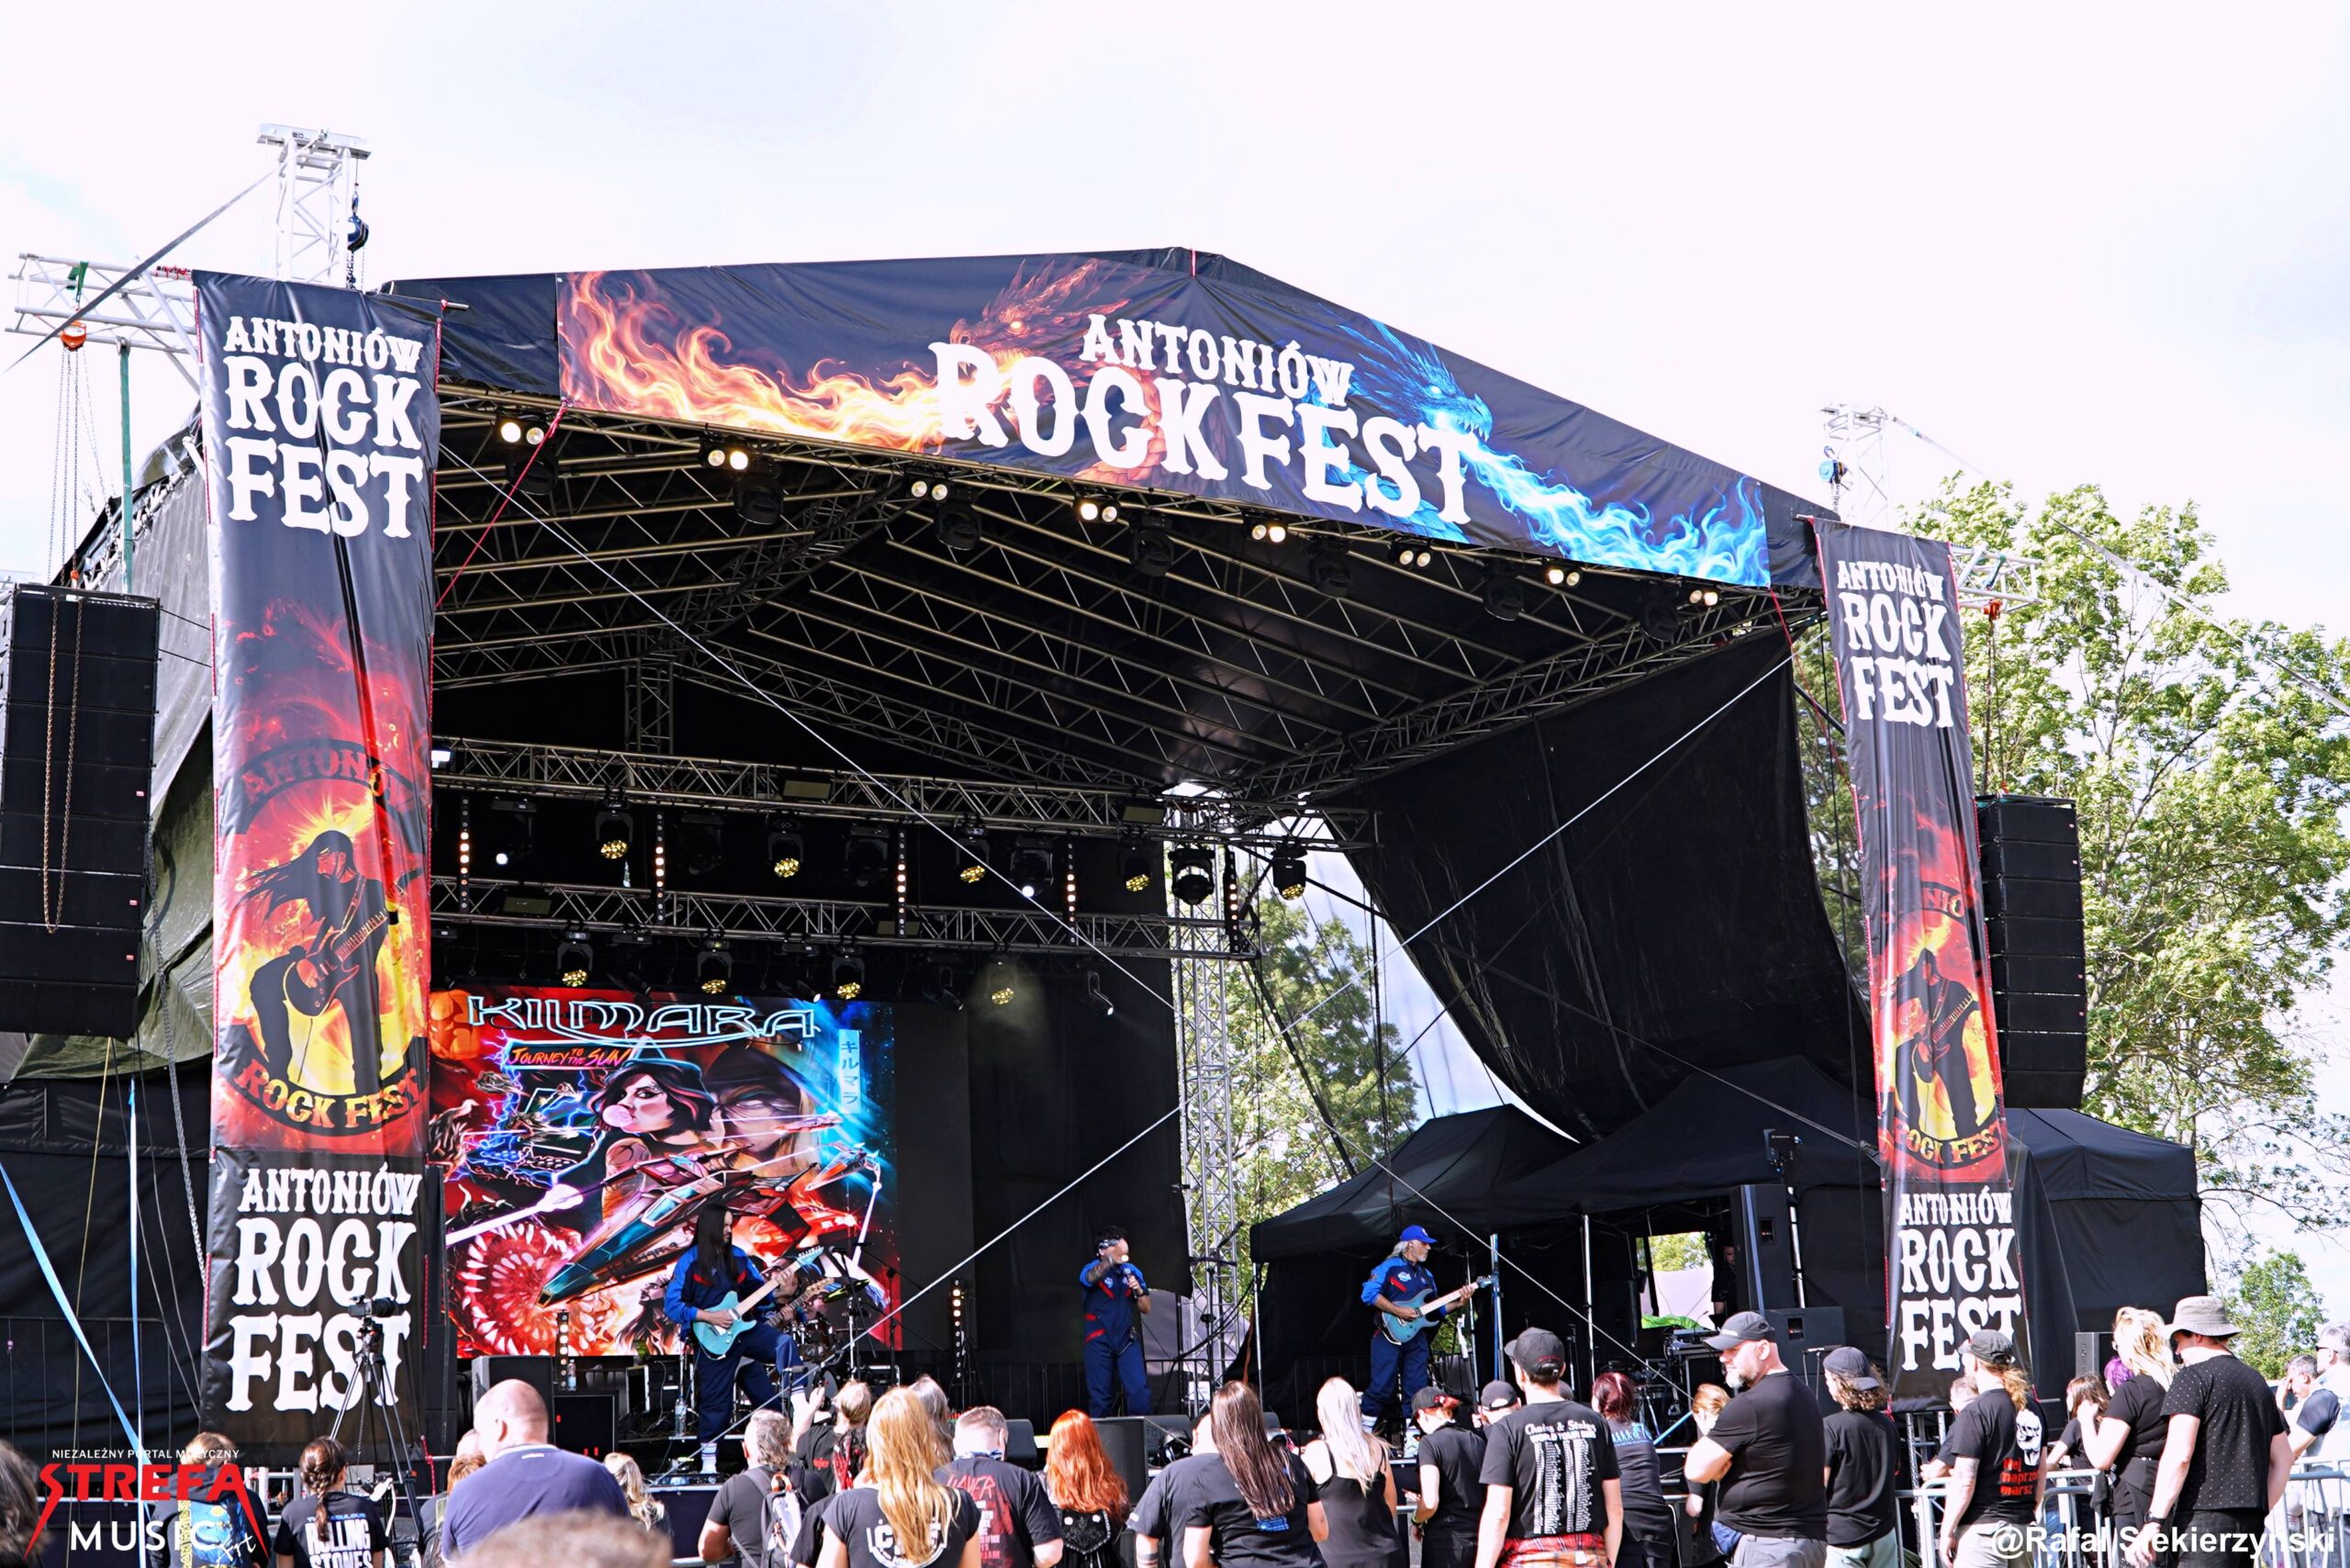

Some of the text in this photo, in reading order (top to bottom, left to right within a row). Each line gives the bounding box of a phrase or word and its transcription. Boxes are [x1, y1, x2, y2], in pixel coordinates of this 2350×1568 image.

[223, 316, 423, 373] ANTONIÓW
[1079, 314, 1356, 407] ANTONIÓW
[223, 355, 422, 450] ROCK
[225, 436, 424, 539] FEST
[1837, 560, 1944, 601] ANTONIÓW
[1839, 592, 1952, 661] ROCK
[1850, 655, 1954, 728] FEST
[468, 996, 821, 1047] KILMARA
[509, 1047, 633, 1067] JOURNEY TO THE SUN
[841, 1041, 859, 1104] キルマラ
[234, 1058, 420, 1128] ROCK FEST
[237, 1161, 422, 1215] ANTONIÓW
[1897, 1185, 2012, 1226] ANTONIÓW
[231, 1217, 417, 1307] ROCK
[1897, 1227, 2020, 1294] ROCK
[226, 1311, 411, 1414] FEST
[1900, 1294, 2022, 1372] FEST
